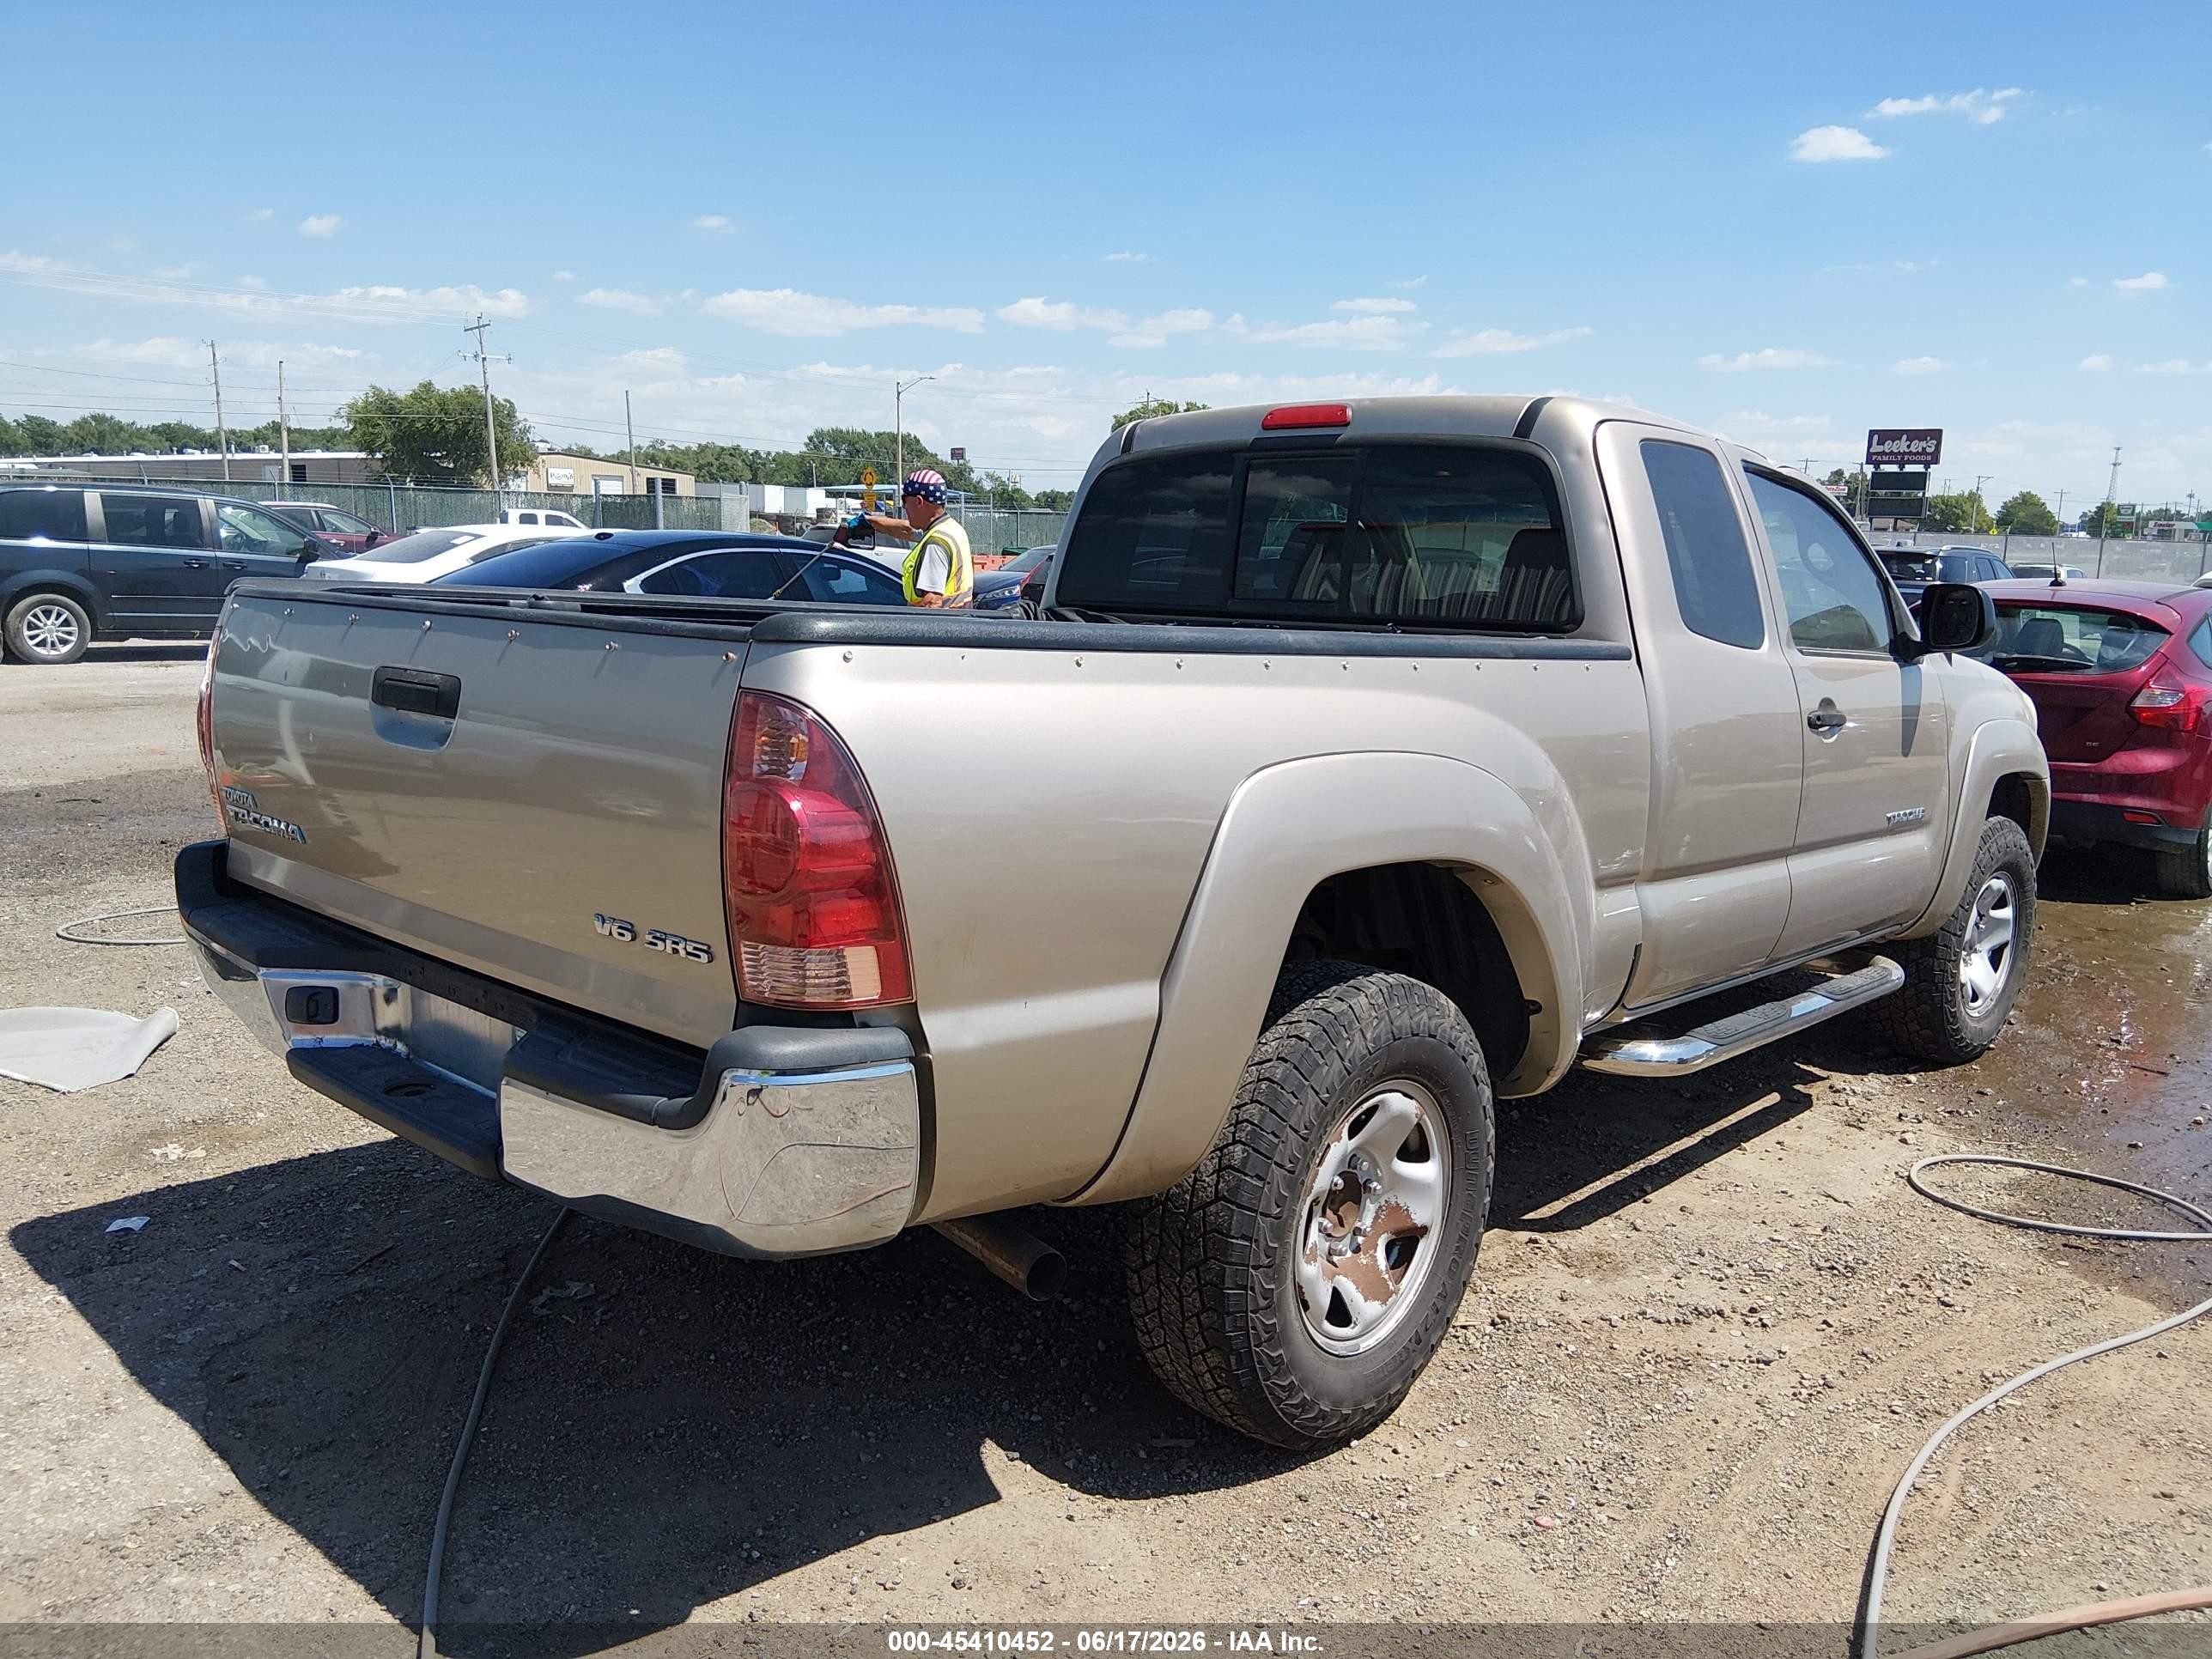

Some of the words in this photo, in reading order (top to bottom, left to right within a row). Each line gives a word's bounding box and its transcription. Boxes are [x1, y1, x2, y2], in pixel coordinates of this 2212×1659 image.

[1869, 434, 1937, 453] Leeker's
[220, 786, 258, 808] TOYOTA
[226, 804, 307, 844] TACOMA
[593, 913, 636, 942] V6
[644, 928, 713, 963] SR5
